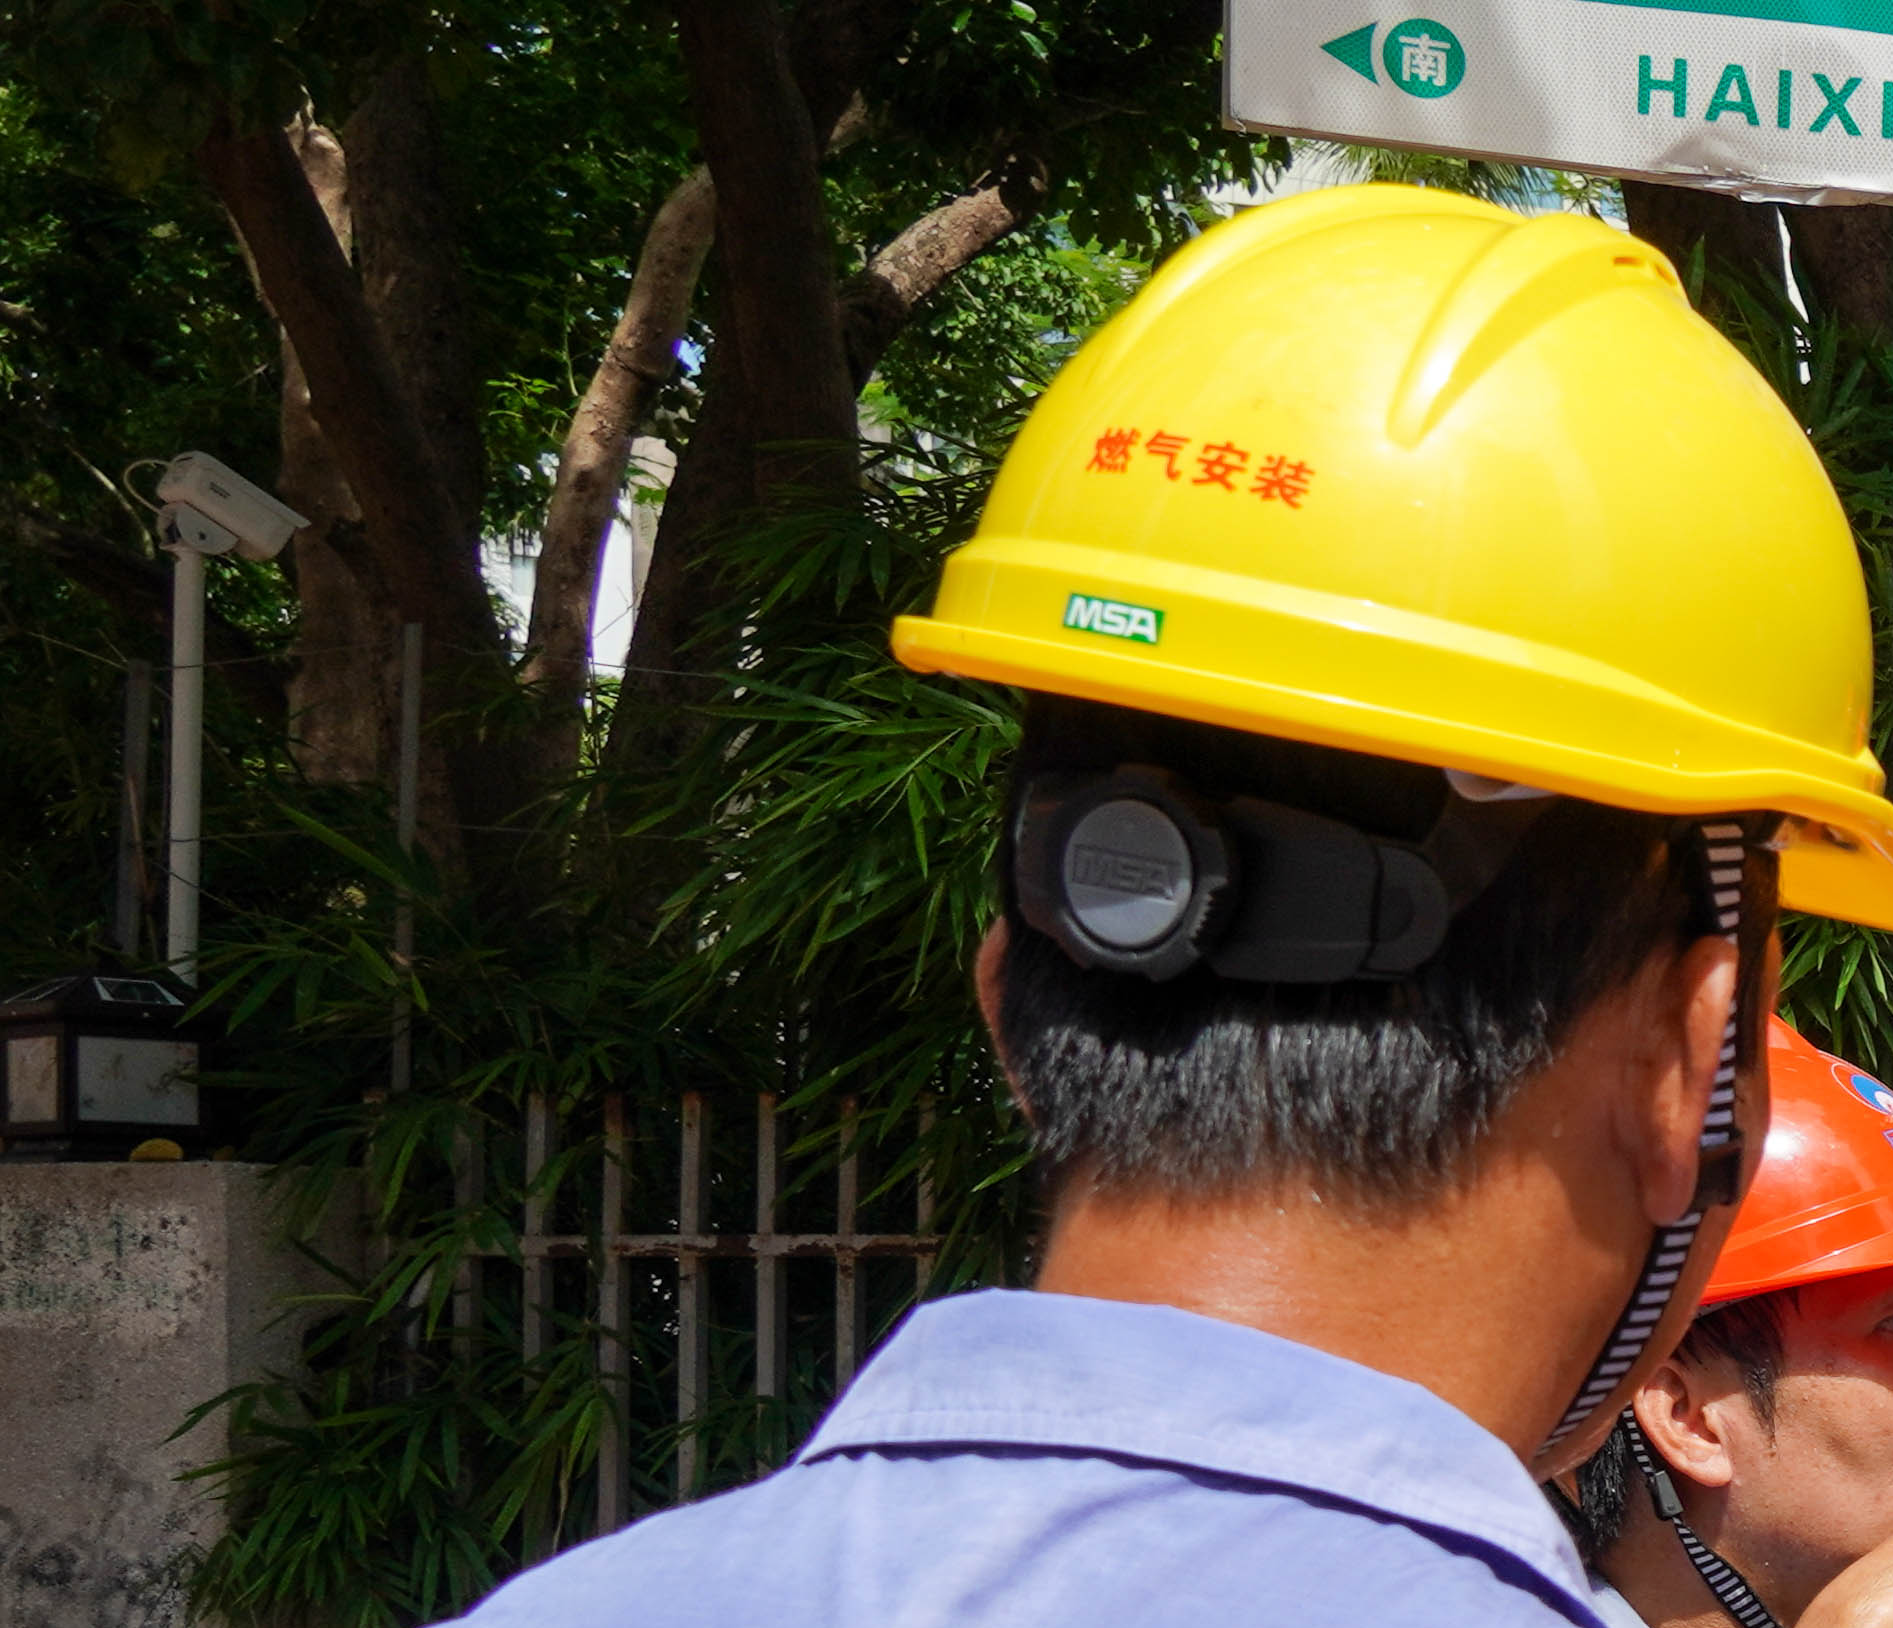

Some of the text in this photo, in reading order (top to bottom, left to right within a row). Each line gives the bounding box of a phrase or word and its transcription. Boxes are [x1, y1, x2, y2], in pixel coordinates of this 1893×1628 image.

[1399, 33, 1451, 86] 南
[1086, 427, 1315, 510] 燃气安装
[1066, 595, 1158, 643] MSA
[1072, 846, 1177, 898] MSA
